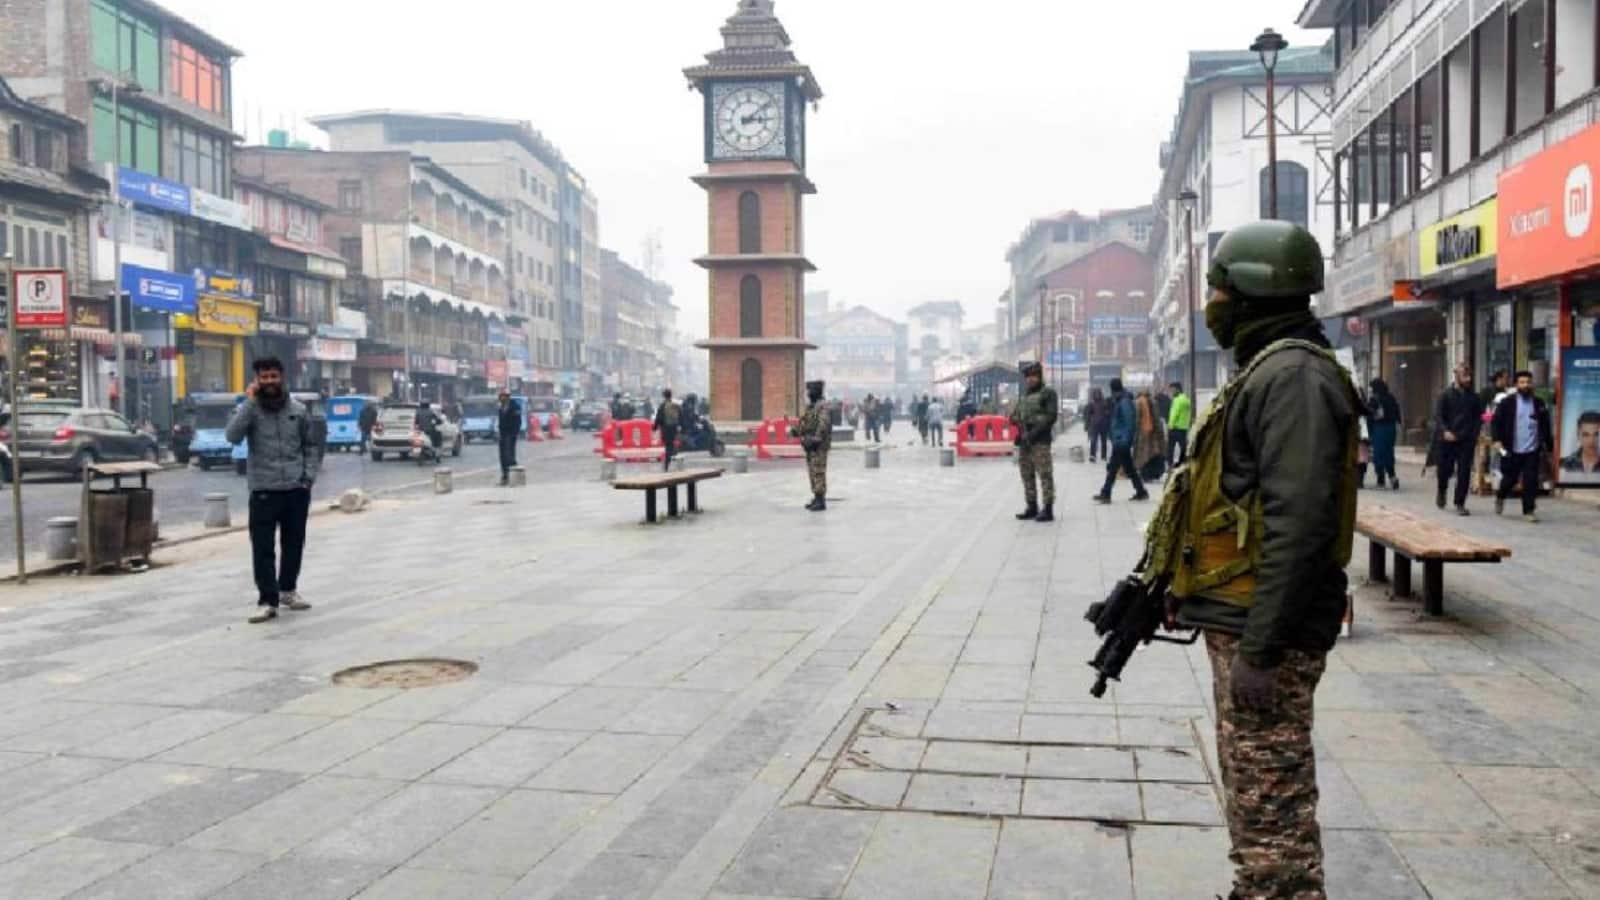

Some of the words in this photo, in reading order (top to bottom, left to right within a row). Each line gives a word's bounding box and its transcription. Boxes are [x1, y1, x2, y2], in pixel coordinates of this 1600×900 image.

[1509, 206, 1551, 236] Xiaomi
[1436, 224, 1481, 266] Nikon
[34, 280, 46, 297] P
